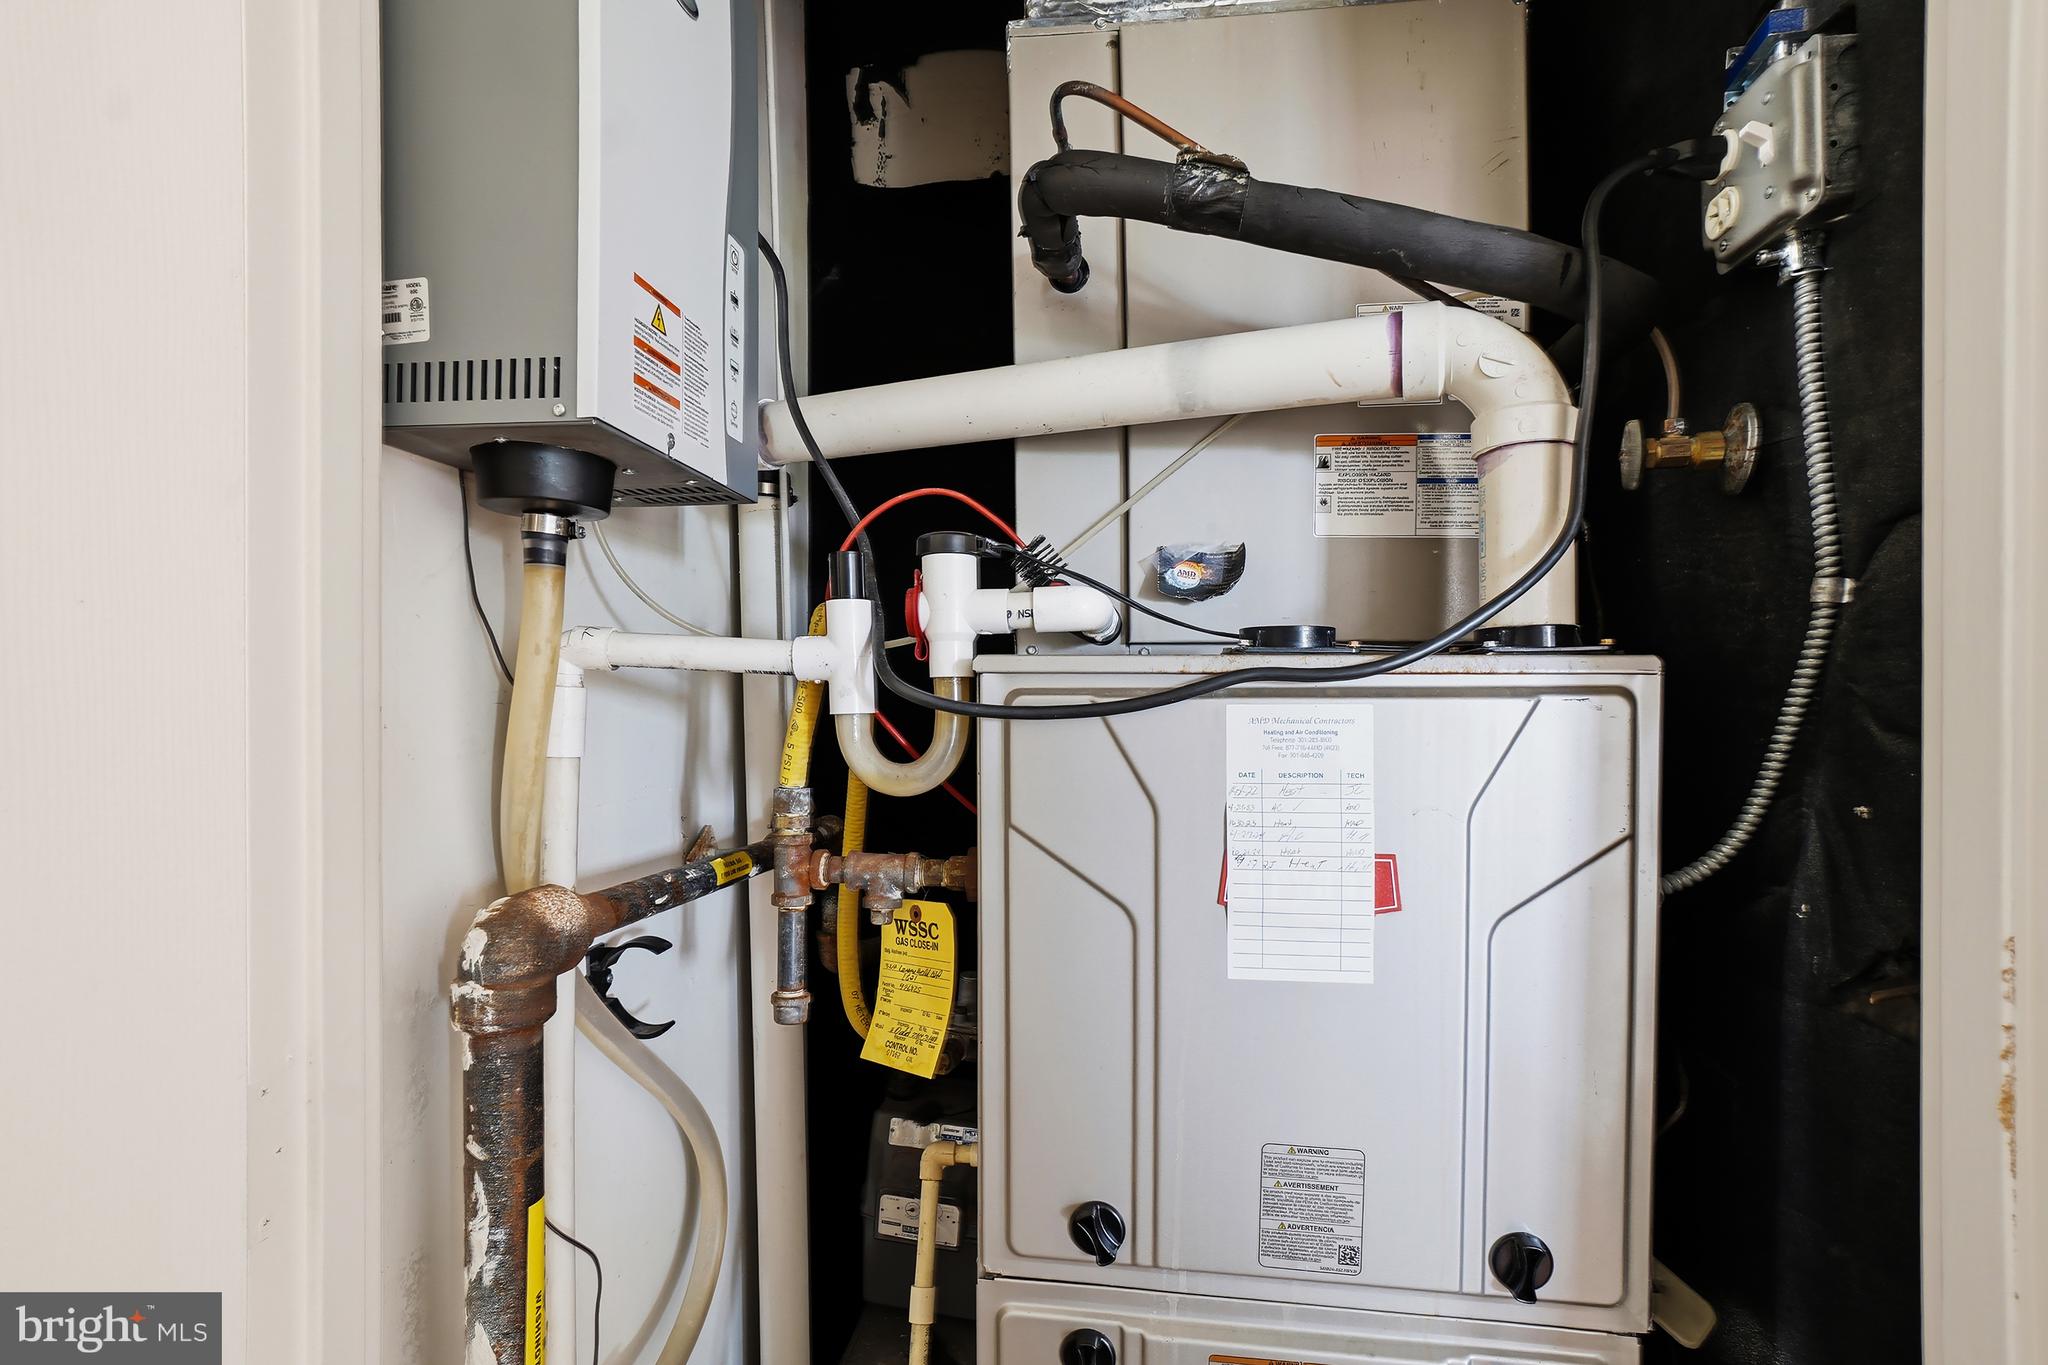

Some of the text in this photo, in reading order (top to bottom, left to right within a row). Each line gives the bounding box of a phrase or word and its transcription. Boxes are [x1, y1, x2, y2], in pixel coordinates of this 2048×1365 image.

[1272, 717, 1313, 725] Mechanical
[1314, 717, 1355, 725] Contractors
[893, 918, 940, 941] WSSC
[895, 936, 939, 951] GAS CLOSE-IN
[1296, 1147, 1329, 1156] WARNING
[1283, 1181, 1339, 1191] AVERTISSEMENT
[1287, 1223, 1335, 1233] ADVERTENCIA
